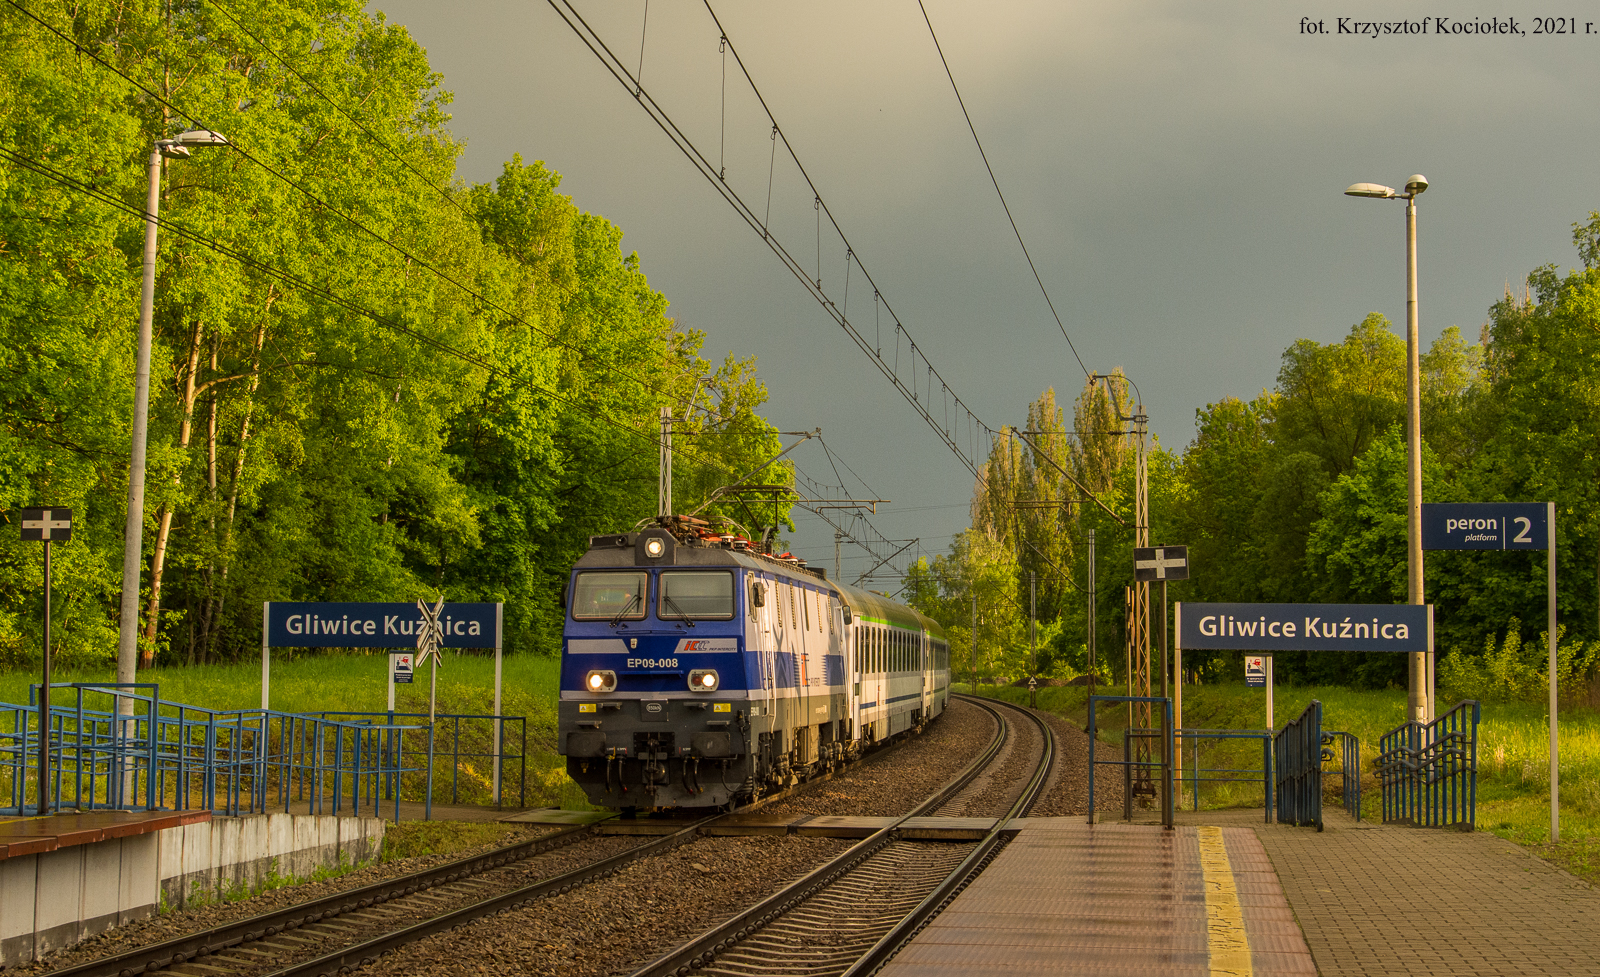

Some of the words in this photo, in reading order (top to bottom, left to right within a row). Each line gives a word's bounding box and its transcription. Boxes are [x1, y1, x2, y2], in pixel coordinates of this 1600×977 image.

[1446, 518, 1498, 534] peron
[1513, 516, 1532, 543] 2
[1464, 533, 1498, 543] platform
[285, 614, 376, 636] Gliwice
[1199, 615, 1297, 637] Gliwice
[1304, 616, 1410, 640] Kuźnica
[627, 658, 679, 669] EP09-008
